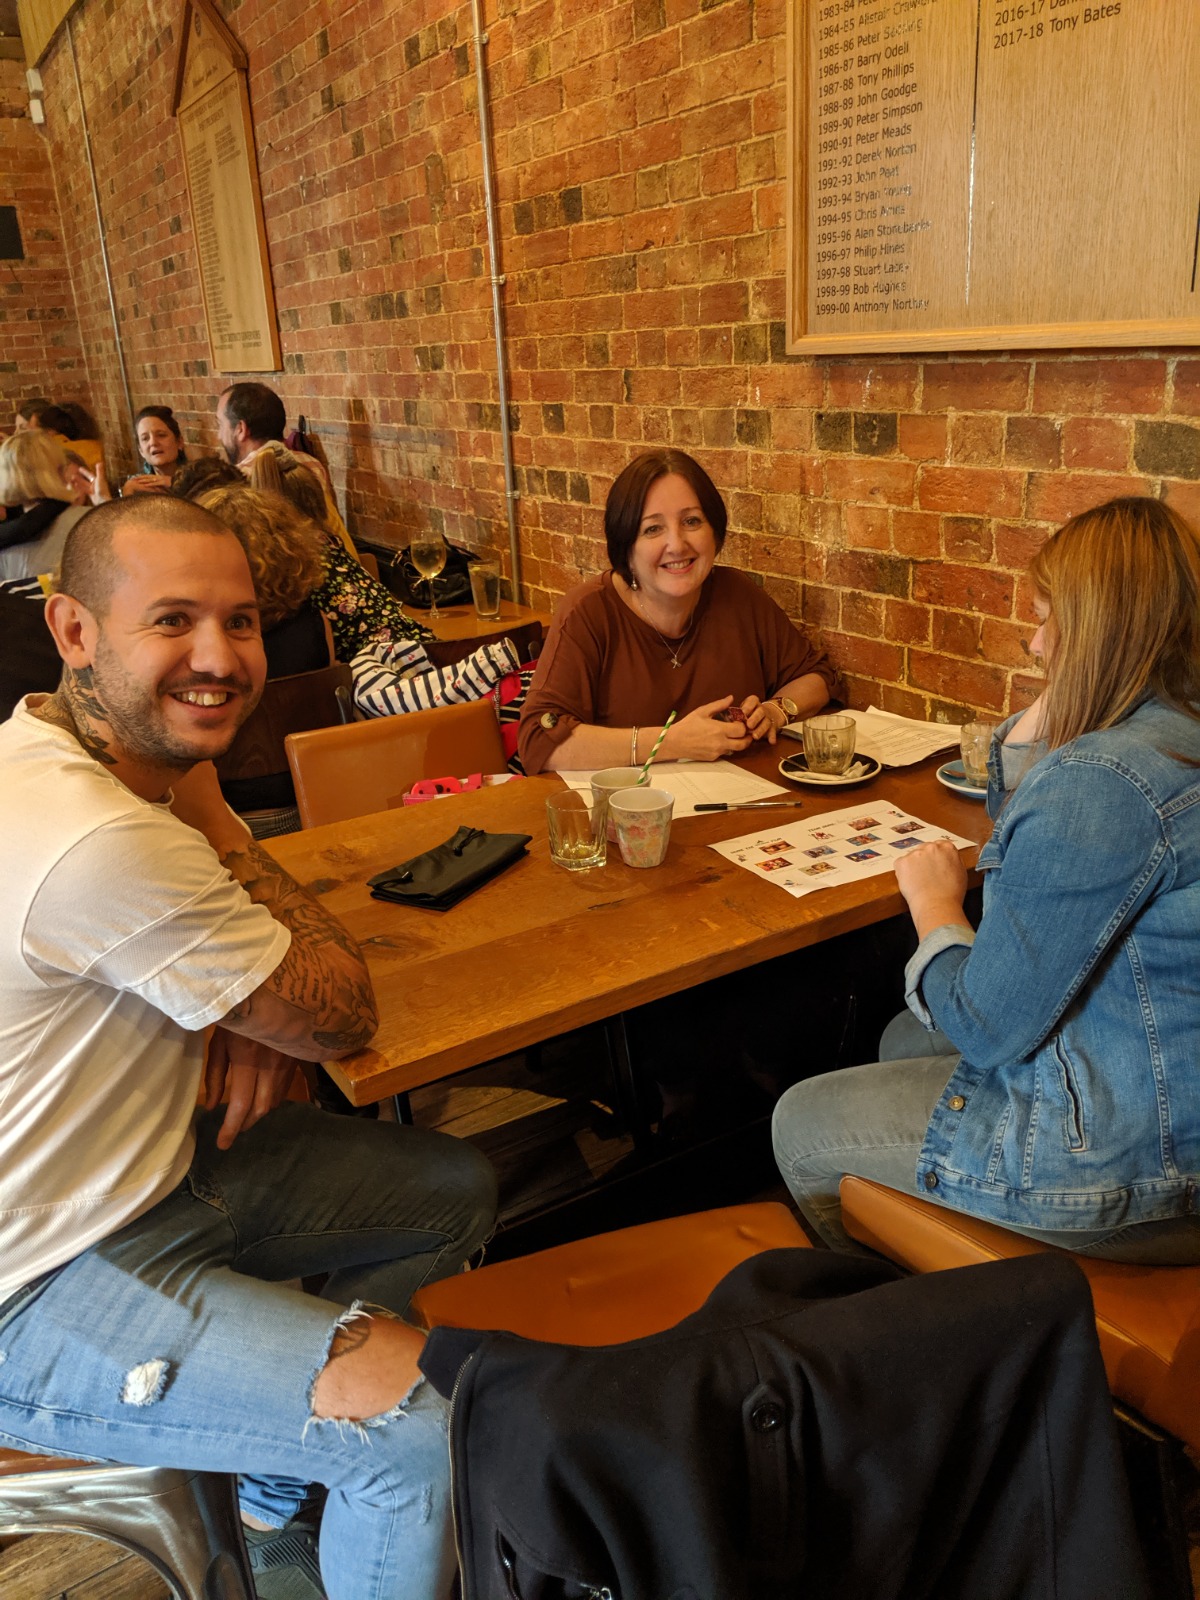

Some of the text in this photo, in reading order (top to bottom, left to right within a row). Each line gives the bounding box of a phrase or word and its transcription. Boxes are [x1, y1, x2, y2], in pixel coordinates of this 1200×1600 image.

[819, 0, 855, 22] 1983-84
[819, 0, 938, 41] 1984-85 Alistair Crawfo
[995, 0, 1045, 26] 2016-17
[993, 2, 1121, 49] 2017-18 Tony Bates
[819, 38, 855, 60] 1985-86
[857, 31, 880, 48] Peter
[818, 41, 909, 79] 1986-87 Barry Odell
[818, 62, 914, 98] 1987-88 Tony Phillips
[818, 82, 917, 117] 1988-89 John Goodge
[818, 100, 923, 136] 1989-90 Peter Simpson
[818, 122, 912, 154] 1990-91 Peter Meads
[818, 142, 917, 172] 1991-92 Derek Norton
[818, 173, 852, 191] 1992-93
[855, 170, 877, 184] John
[817, 192, 852, 209] 1993-94
[855, 189, 880, 204] Bryan
[817, 211, 852, 227] 1994-95
[855, 208, 877, 221] Chris
[817, 229, 851, 245] 1995-96
[855, 227, 874, 240] Alan
[817, 243, 905, 263] 1996-97 Philip Hines
[816, 266, 851, 280] 1997-98
[854, 263, 881, 277] Stuart
[816, 280, 906, 298] 1998-99 Bob Hughes
[816, 302, 850, 316] 1999-00
[853, 300, 889, 313] Anthony
